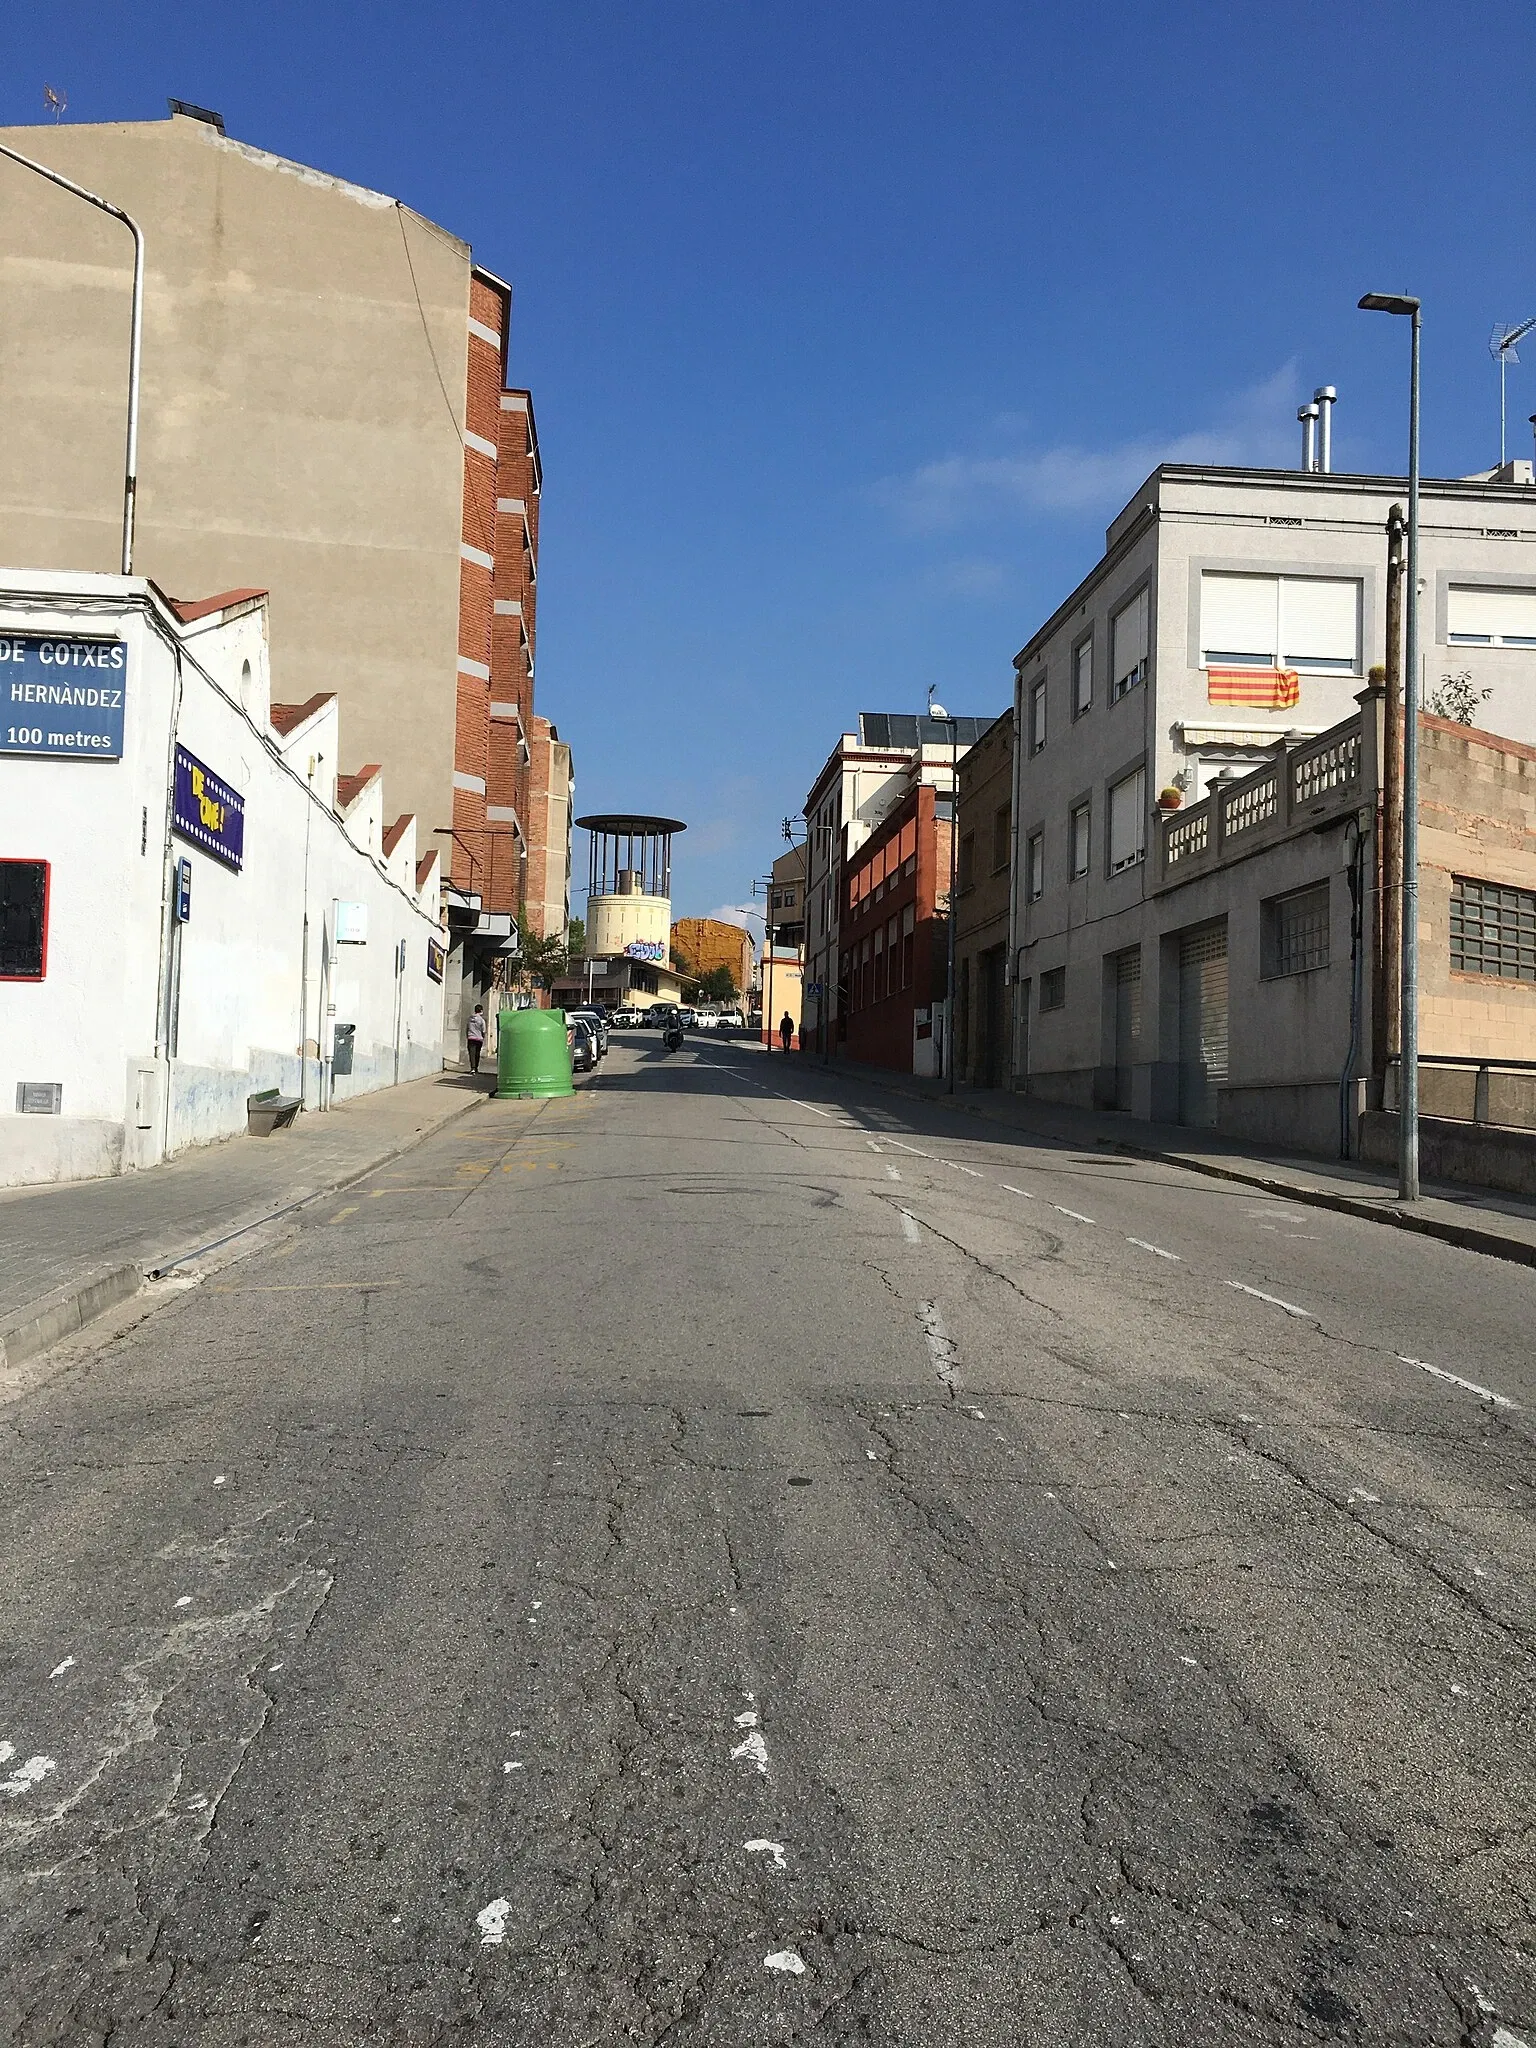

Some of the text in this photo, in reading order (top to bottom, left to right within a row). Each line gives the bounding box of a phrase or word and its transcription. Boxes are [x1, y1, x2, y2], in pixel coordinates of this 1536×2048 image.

[0, 640, 124, 669] DE COTXES
[10, 682, 122, 708] HERNÀNDEZ
[7, 726, 112, 748] 100 metres
